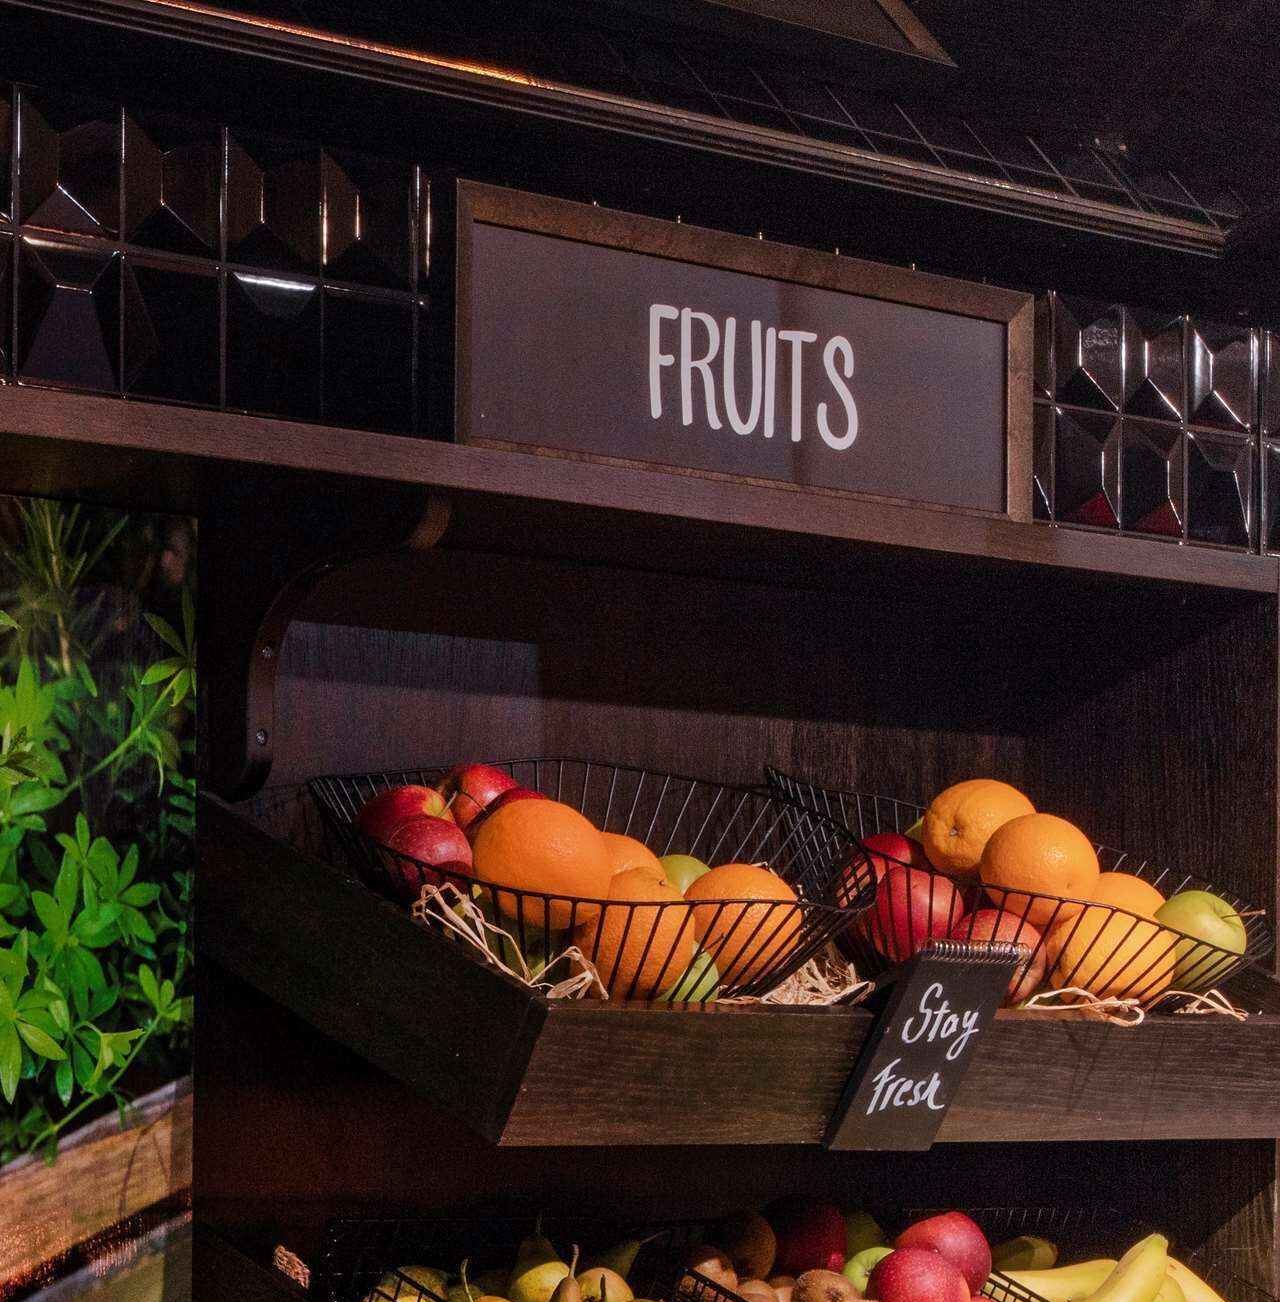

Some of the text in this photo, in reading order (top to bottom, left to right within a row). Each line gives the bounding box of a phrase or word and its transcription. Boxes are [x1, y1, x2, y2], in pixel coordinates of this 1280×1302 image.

[649, 303, 859, 450] FRUITS
[901, 982, 980, 1061] Stay
[866, 1057, 945, 1115] Fresh
